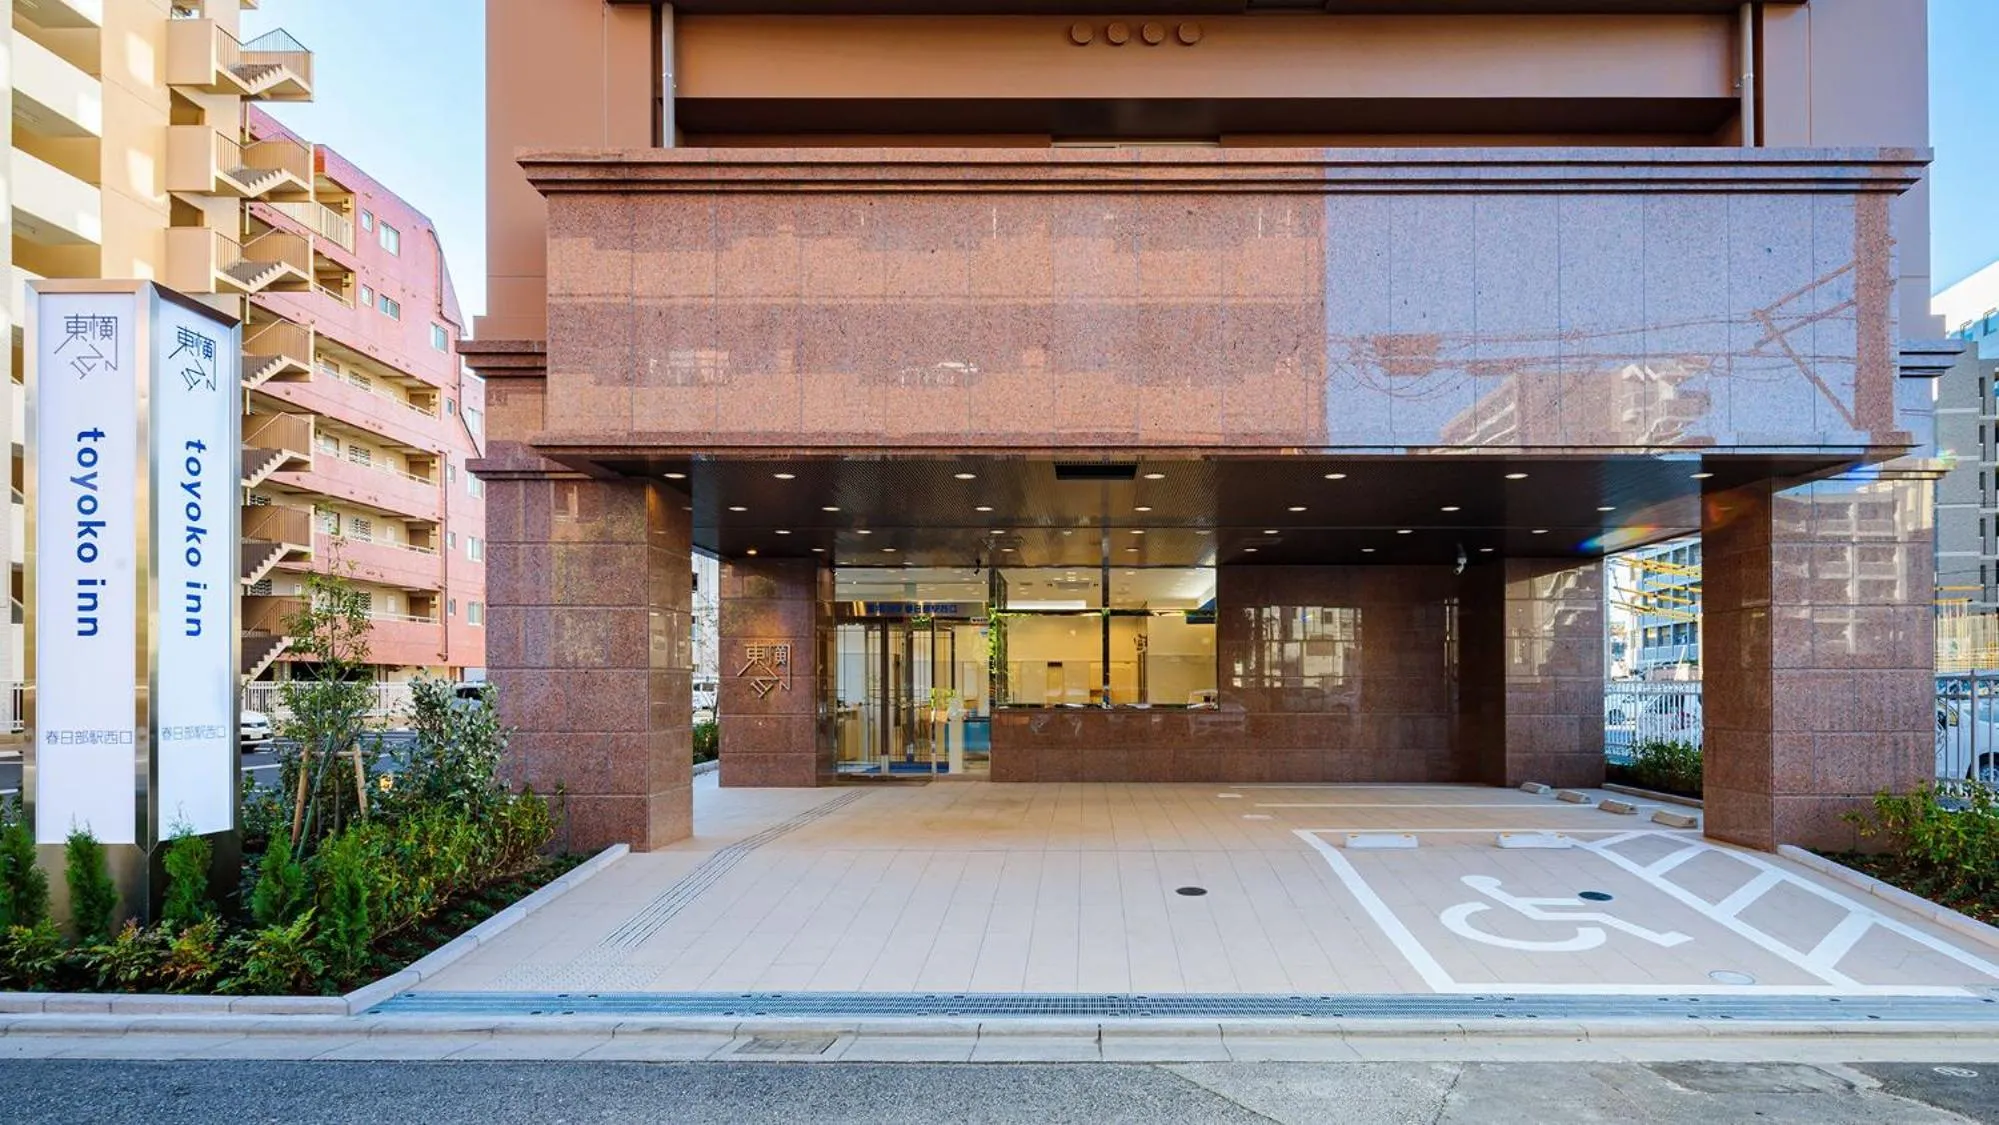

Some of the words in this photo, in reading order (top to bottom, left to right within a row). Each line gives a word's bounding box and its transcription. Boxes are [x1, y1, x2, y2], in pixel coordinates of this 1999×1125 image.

[70, 428, 106, 563] toyoko
[180, 439, 207, 567] toyoko
[77, 579, 106, 637] inn
[185, 581, 207, 637] inn
[46, 730, 133, 745] 春日部駅西口
